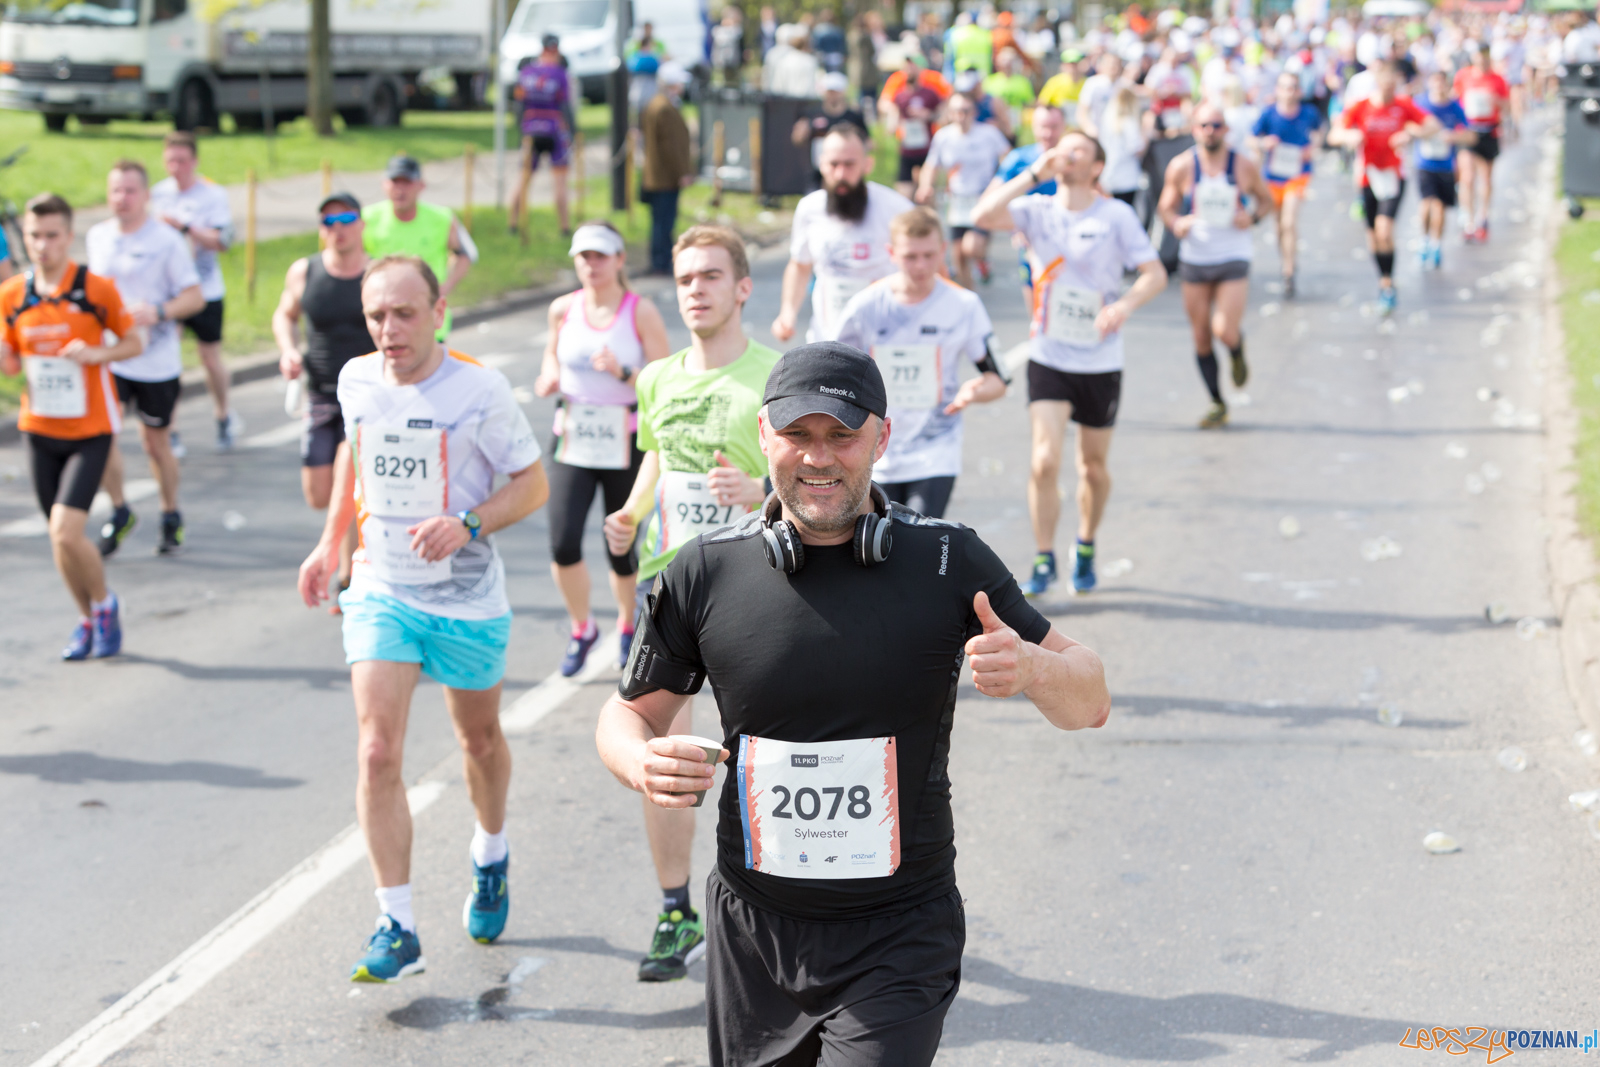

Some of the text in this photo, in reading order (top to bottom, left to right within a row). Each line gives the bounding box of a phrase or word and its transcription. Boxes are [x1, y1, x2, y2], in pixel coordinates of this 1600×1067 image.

[892, 366, 919, 381] 717
[820, 385, 848, 396] Reebok
[374, 455, 427, 479] 8291
[678, 502, 733, 525] 9327
[938, 543, 949, 576] Reebok
[634, 653, 648, 681] Reebok
[802, 757, 817, 765] PKO
[771, 784, 872, 821] 2078
[794, 828, 849, 841] Sylwester
